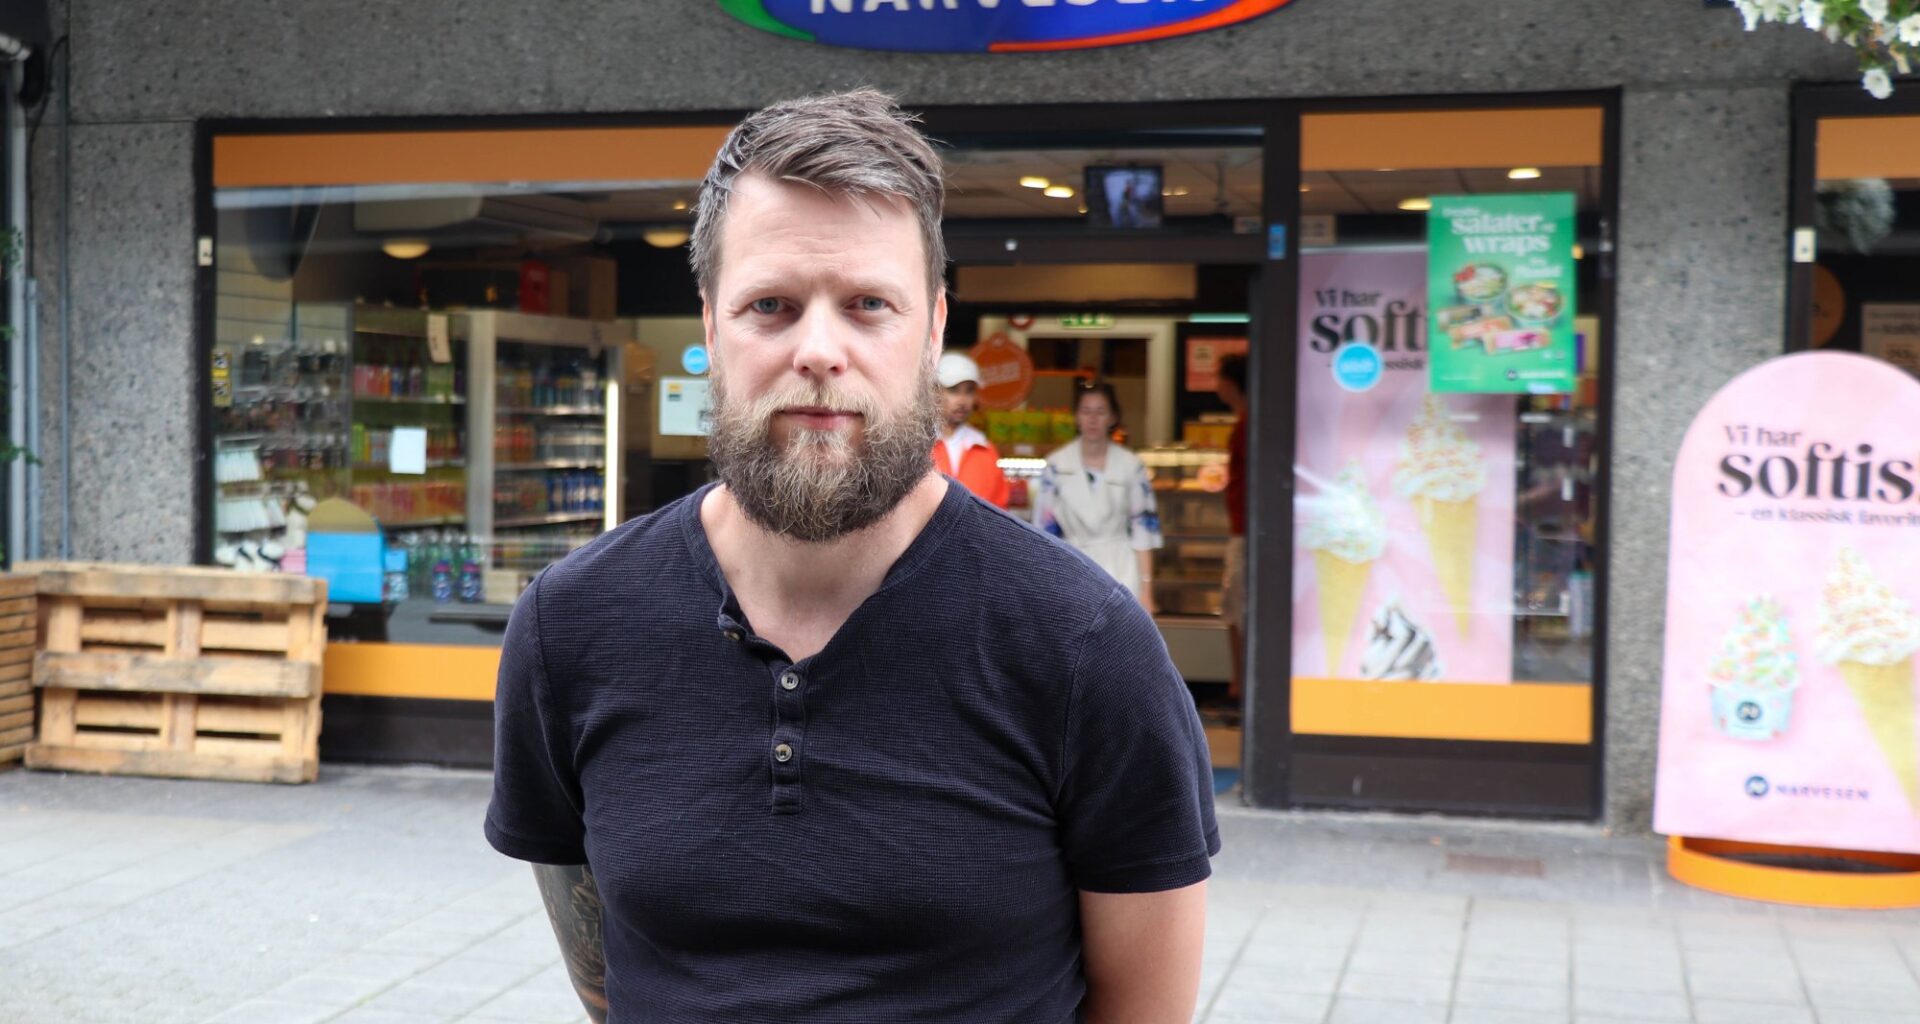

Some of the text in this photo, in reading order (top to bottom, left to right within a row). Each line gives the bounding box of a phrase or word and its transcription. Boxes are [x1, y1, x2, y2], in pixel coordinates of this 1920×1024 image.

[1451, 213, 1543, 234] salater
[1463, 234, 1550, 256] wraps
[1314, 288, 1382, 307] Vi har
[1724, 424, 1801, 446] Vi har
[1717, 442, 1920, 504] softis
[1751, 508, 1772, 521] en
[1776, 784, 1869, 800] NARVESEN
